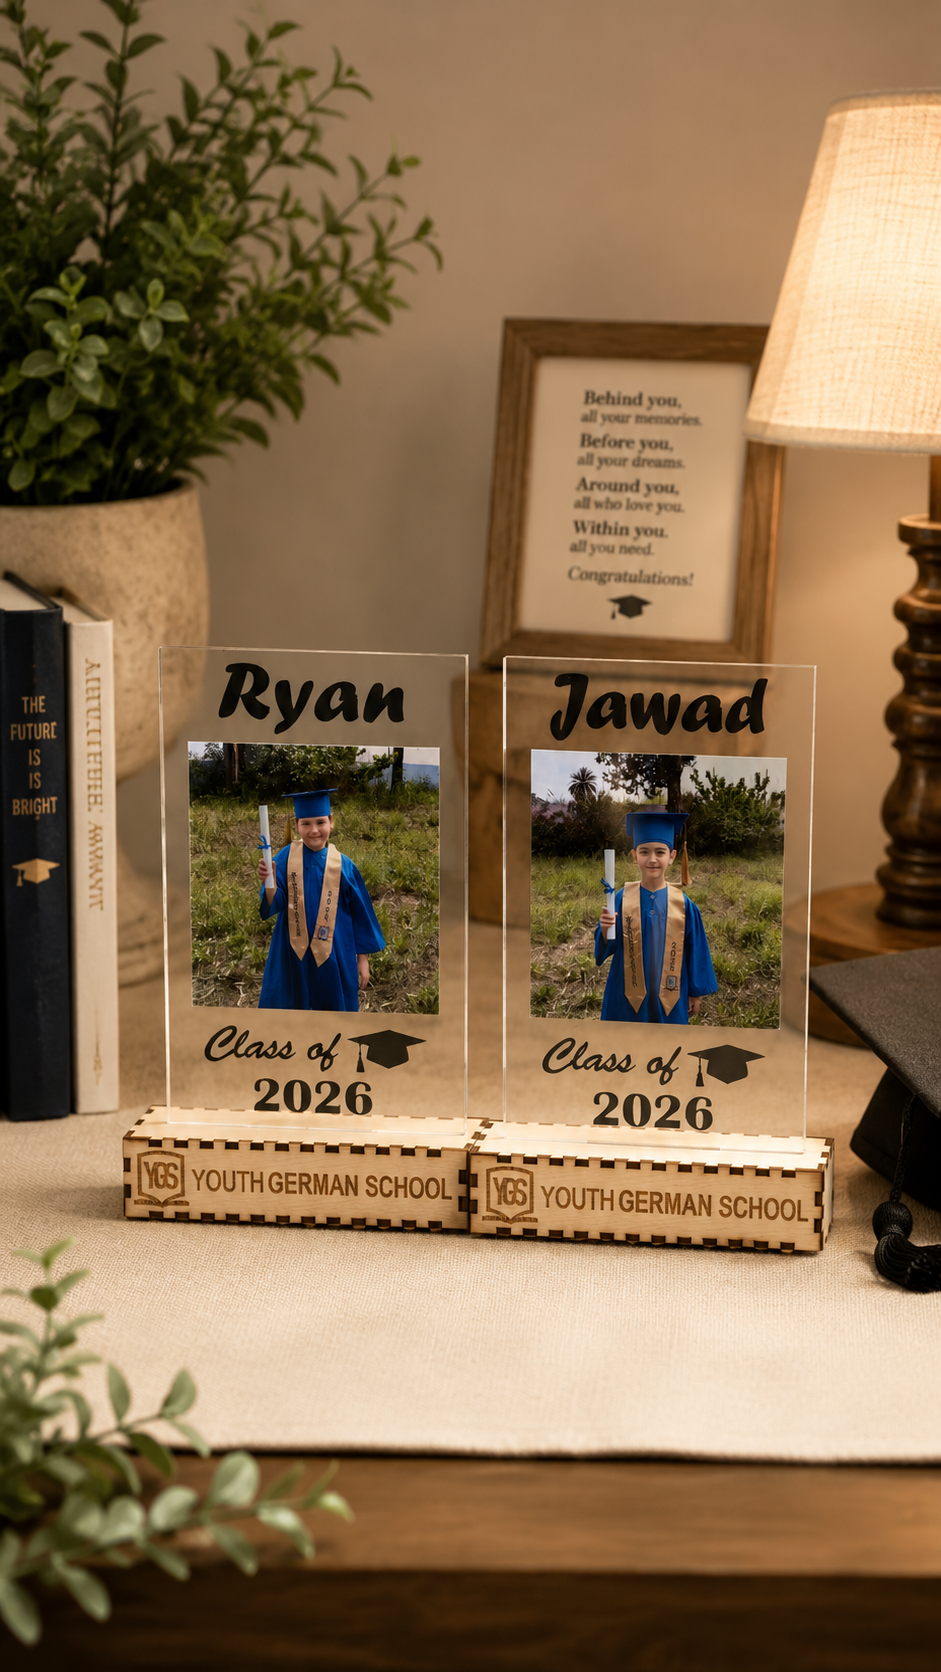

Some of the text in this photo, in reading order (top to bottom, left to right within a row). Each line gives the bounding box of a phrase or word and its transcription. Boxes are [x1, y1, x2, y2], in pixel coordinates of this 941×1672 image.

[584, 390, 682, 411] Behind you,
[580, 409, 703, 427] all your memories.
[580, 433, 674, 454] Before you,
[577, 452, 686, 470] all your dreams.
[575, 477, 680, 498] Around you,
[573, 496, 686, 516] all who love you.
[573, 520, 630, 536] Within
[569, 540, 655, 557] all you need.
[567, 566, 694, 586] Congratulations!
[21, 696, 46, 714] THE
[218, 662, 404, 735] Ryan
[550, 672, 768, 741] Jawad
[10, 722, 57, 741] FUTURE
[28, 748, 41, 766] IS
[29, 772, 42, 790] IS
[12, 796, 58, 816] BRIGHT
[204, 1024, 342, 1072] Class of
[542, 1037, 682, 1086] Class of
[254, 1078, 373, 1116] 2026
[592, 1091, 713, 1131] 2026
[143, 1161, 179, 1190] YGS
[192, 1168, 452, 1200] YOUTH GERMAN SCHOOL
[492, 1176, 528, 1207] YGS
[541, 1185, 808, 1223] YOUTH GERMAN SCHOOL
